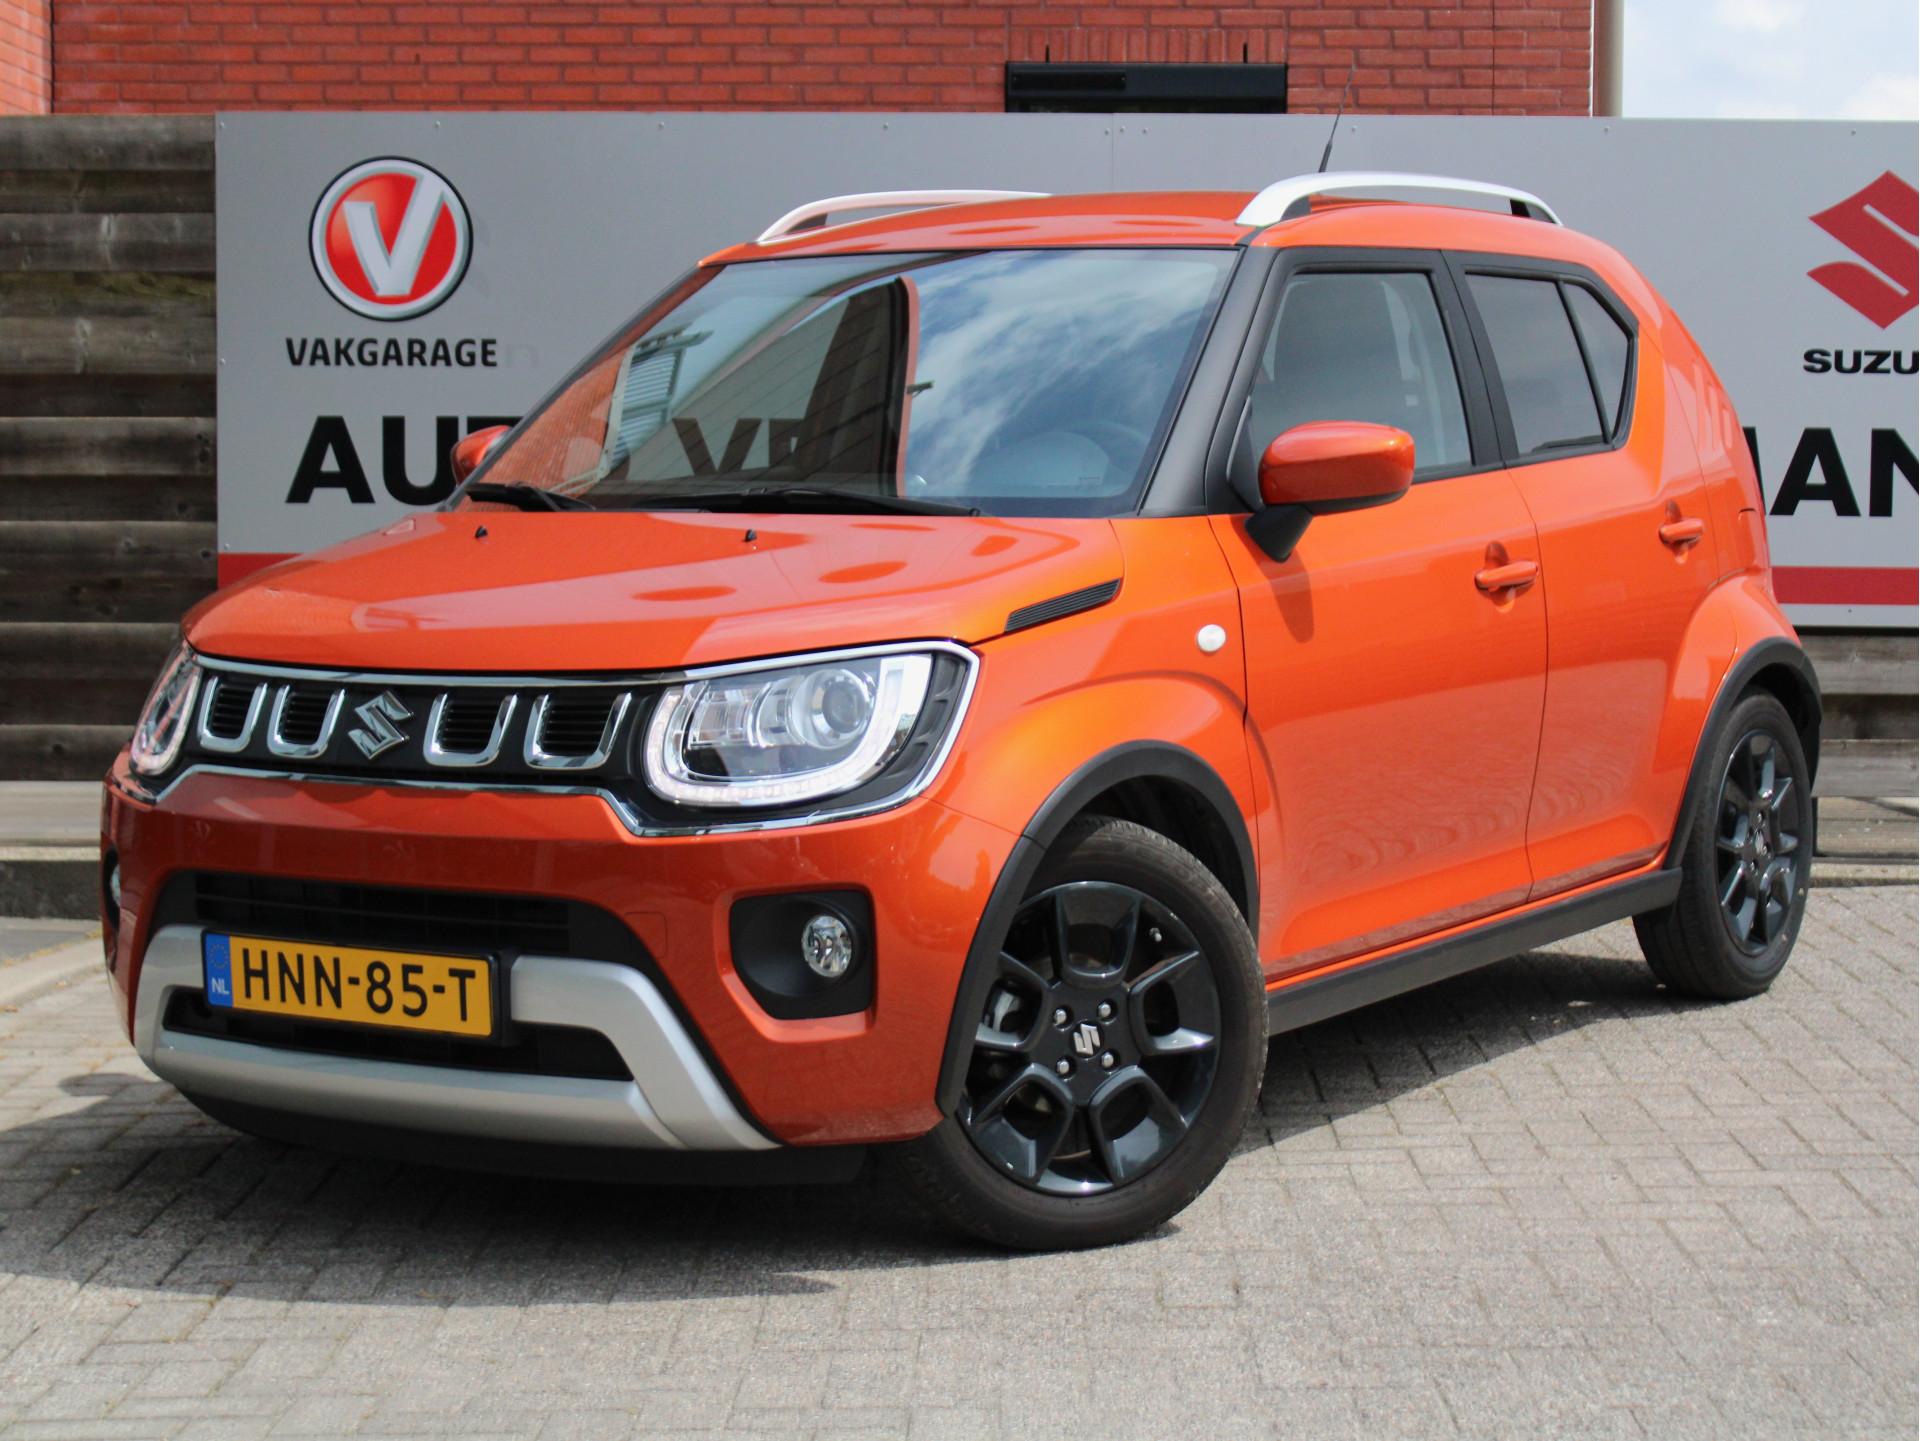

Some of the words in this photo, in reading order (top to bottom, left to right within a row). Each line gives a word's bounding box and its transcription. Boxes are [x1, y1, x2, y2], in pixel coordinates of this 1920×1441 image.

[286, 337, 498, 367] VAKGARAGE
[1803, 348, 1920, 375] SUZU
[211, 976, 230, 995] NL
[242, 947, 477, 1022] HNN-85-T
